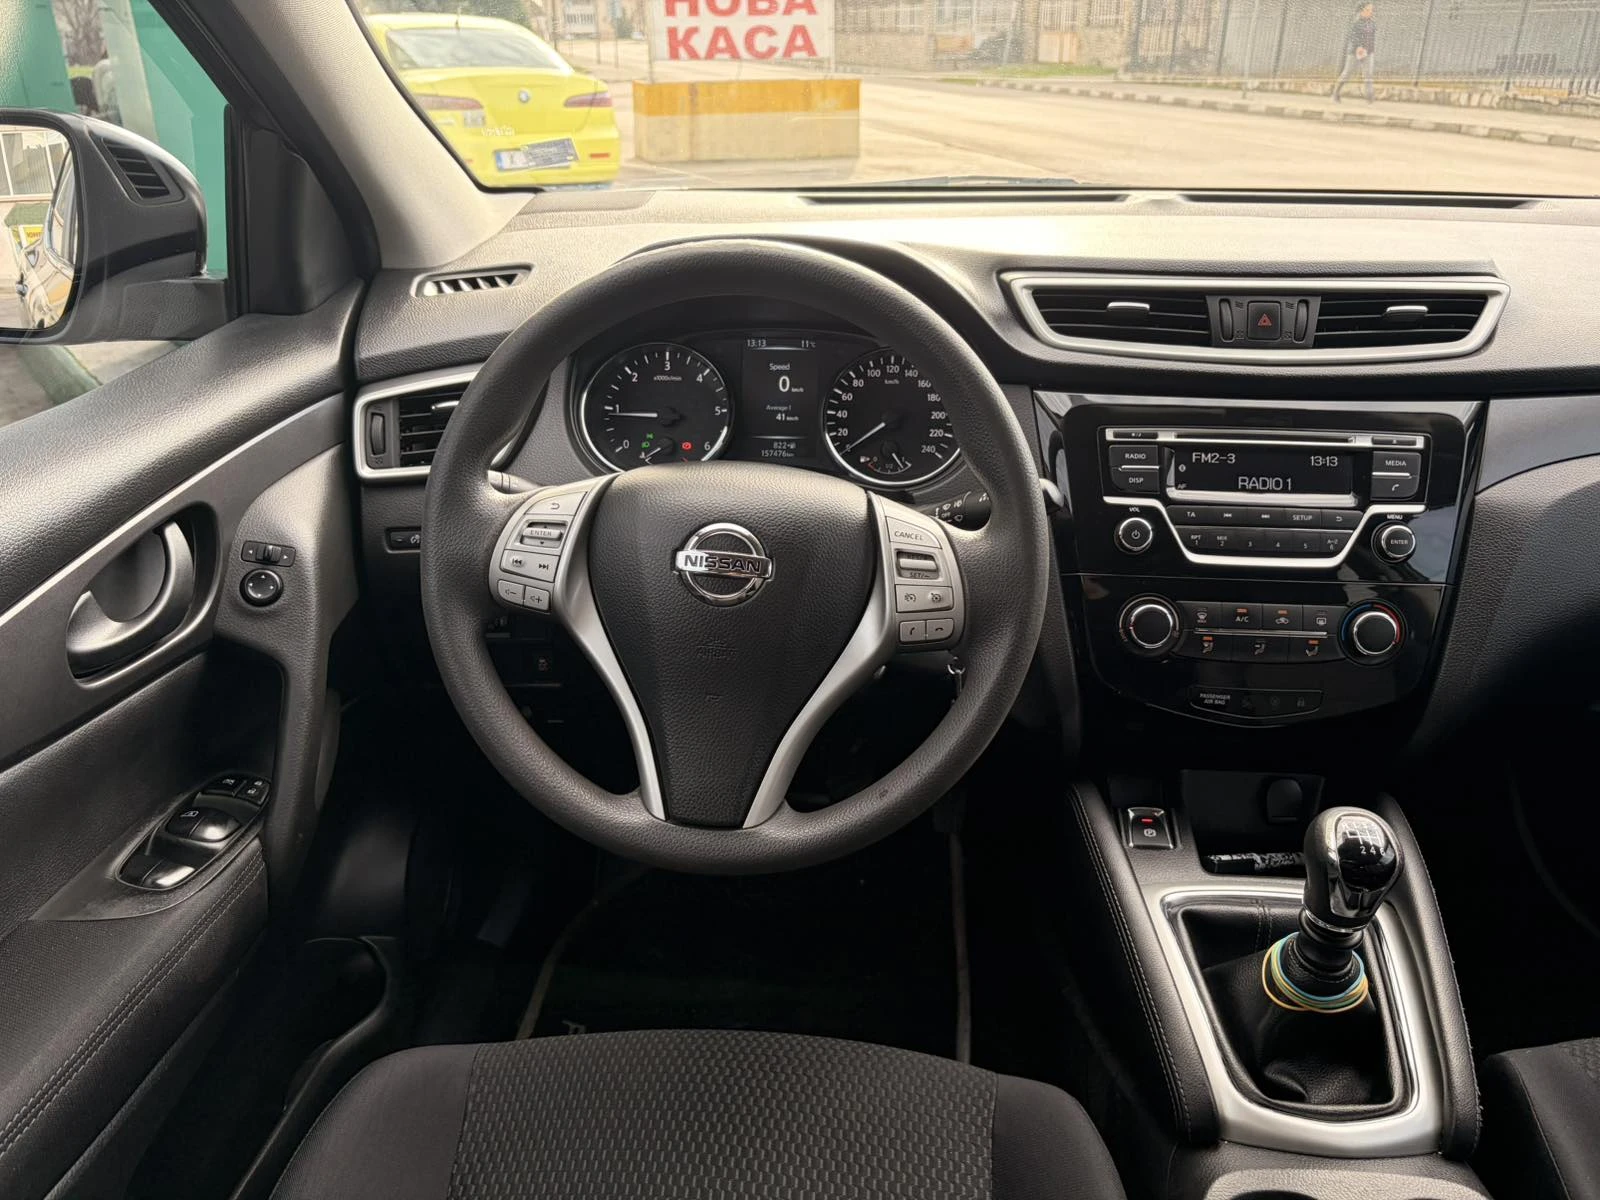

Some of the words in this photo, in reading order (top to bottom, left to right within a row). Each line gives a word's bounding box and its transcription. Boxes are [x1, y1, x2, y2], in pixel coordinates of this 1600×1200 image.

[667, 25, 818, 60] КАСА
[747, 339, 767, 348] 13:13
[664, 361, 671, 371] 3
[769, 363, 791, 372] Speed
[886, 365, 900, 374] 120
[632, 372, 639, 382] 2
[867, 369, 881, 378] 100
[904, 369, 919, 378] 140
[696, 374, 703, 384] 4
[852, 378, 865, 388] 80
[778, 376, 790, 392] 0
[841, 392, 854, 401] 60
[714, 406, 722, 416] 5
[836, 410, 848, 418] 40
[930, 411, 946, 420] 200
[776, 413, 786, 422] 41
[837, 428, 848, 437] 20
[929, 428, 945, 438] 220
[622, 440, 630, 449] 0
[704, 442, 712, 451] 6
[773, 441, 787, 450] 822
[920, 444, 936, 454] 240
[1192, 452, 1236, 464] FM2-3
[1310, 456, 1338, 467] 13:13
[1128, 476, 1144, 484] DISP
[1238, 476, 1283, 492] RADIO
[530, 528, 553, 538] ENTER
[894, 530, 924, 542] CANCEL
[684, 554, 761, 573] NISSAN
[1360, 846, 1367, 855] 2
[1370, 846, 1377, 856] 4
[1380, 848, 1386, 856] 6
